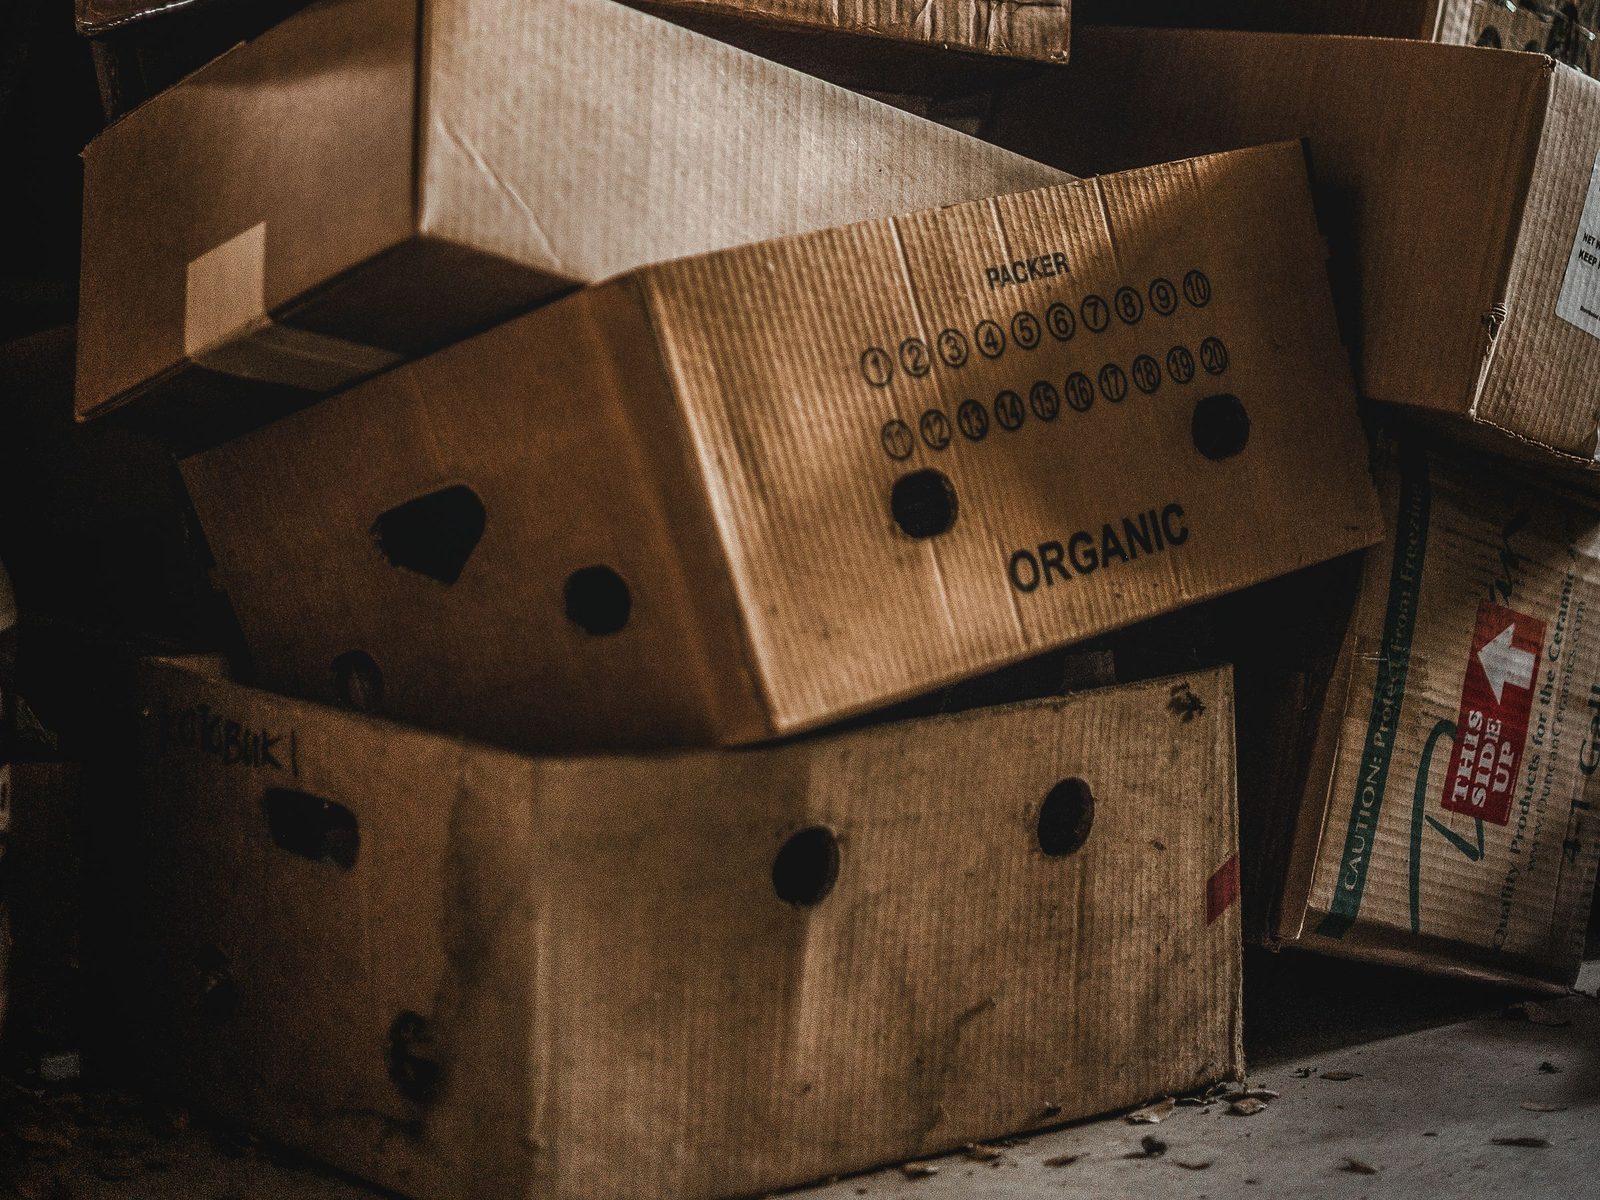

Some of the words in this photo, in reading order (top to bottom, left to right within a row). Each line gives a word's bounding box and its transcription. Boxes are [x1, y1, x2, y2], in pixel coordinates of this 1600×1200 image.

[984, 251, 1070, 289] PACKER
[1579, 249, 1597, 266] KEEP
[1583, 232, 1595, 246] NET
[886, 426, 908, 454] 11
[923, 414, 950, 448] 12
[961, 405, 987, 437] 13
[999, 393, 1022, 425] 14
[1034, 384, 1057, 417] 15
[1069, 375, 1091, 407] 16
[1102, 367, 1121, 400] 17
[1136, 359, 1158, 389] 18
[1171, 350, 1193, 380] 19
[1204, 343, 1226, 373] 20
[1008, 502, 1190, 594] ORGANIC
[1344, 755, 1382, 892] CAUTION:
[1373, 657, 1403, 748] Protect
[1452, 709, 1483, 803] THIS
[1471, 717, 1502, 809] SIDE
[1492, 740, 1515, 794] UP
[1528, 601, 1586, 871] www.DuncanCeramics.com
[1493, 863, 1520, 951] Quality
[1510, 753, 1541, 855] Products
[1531, 712, 1547, 747] for
[1539, 669, 1556, 704] the
